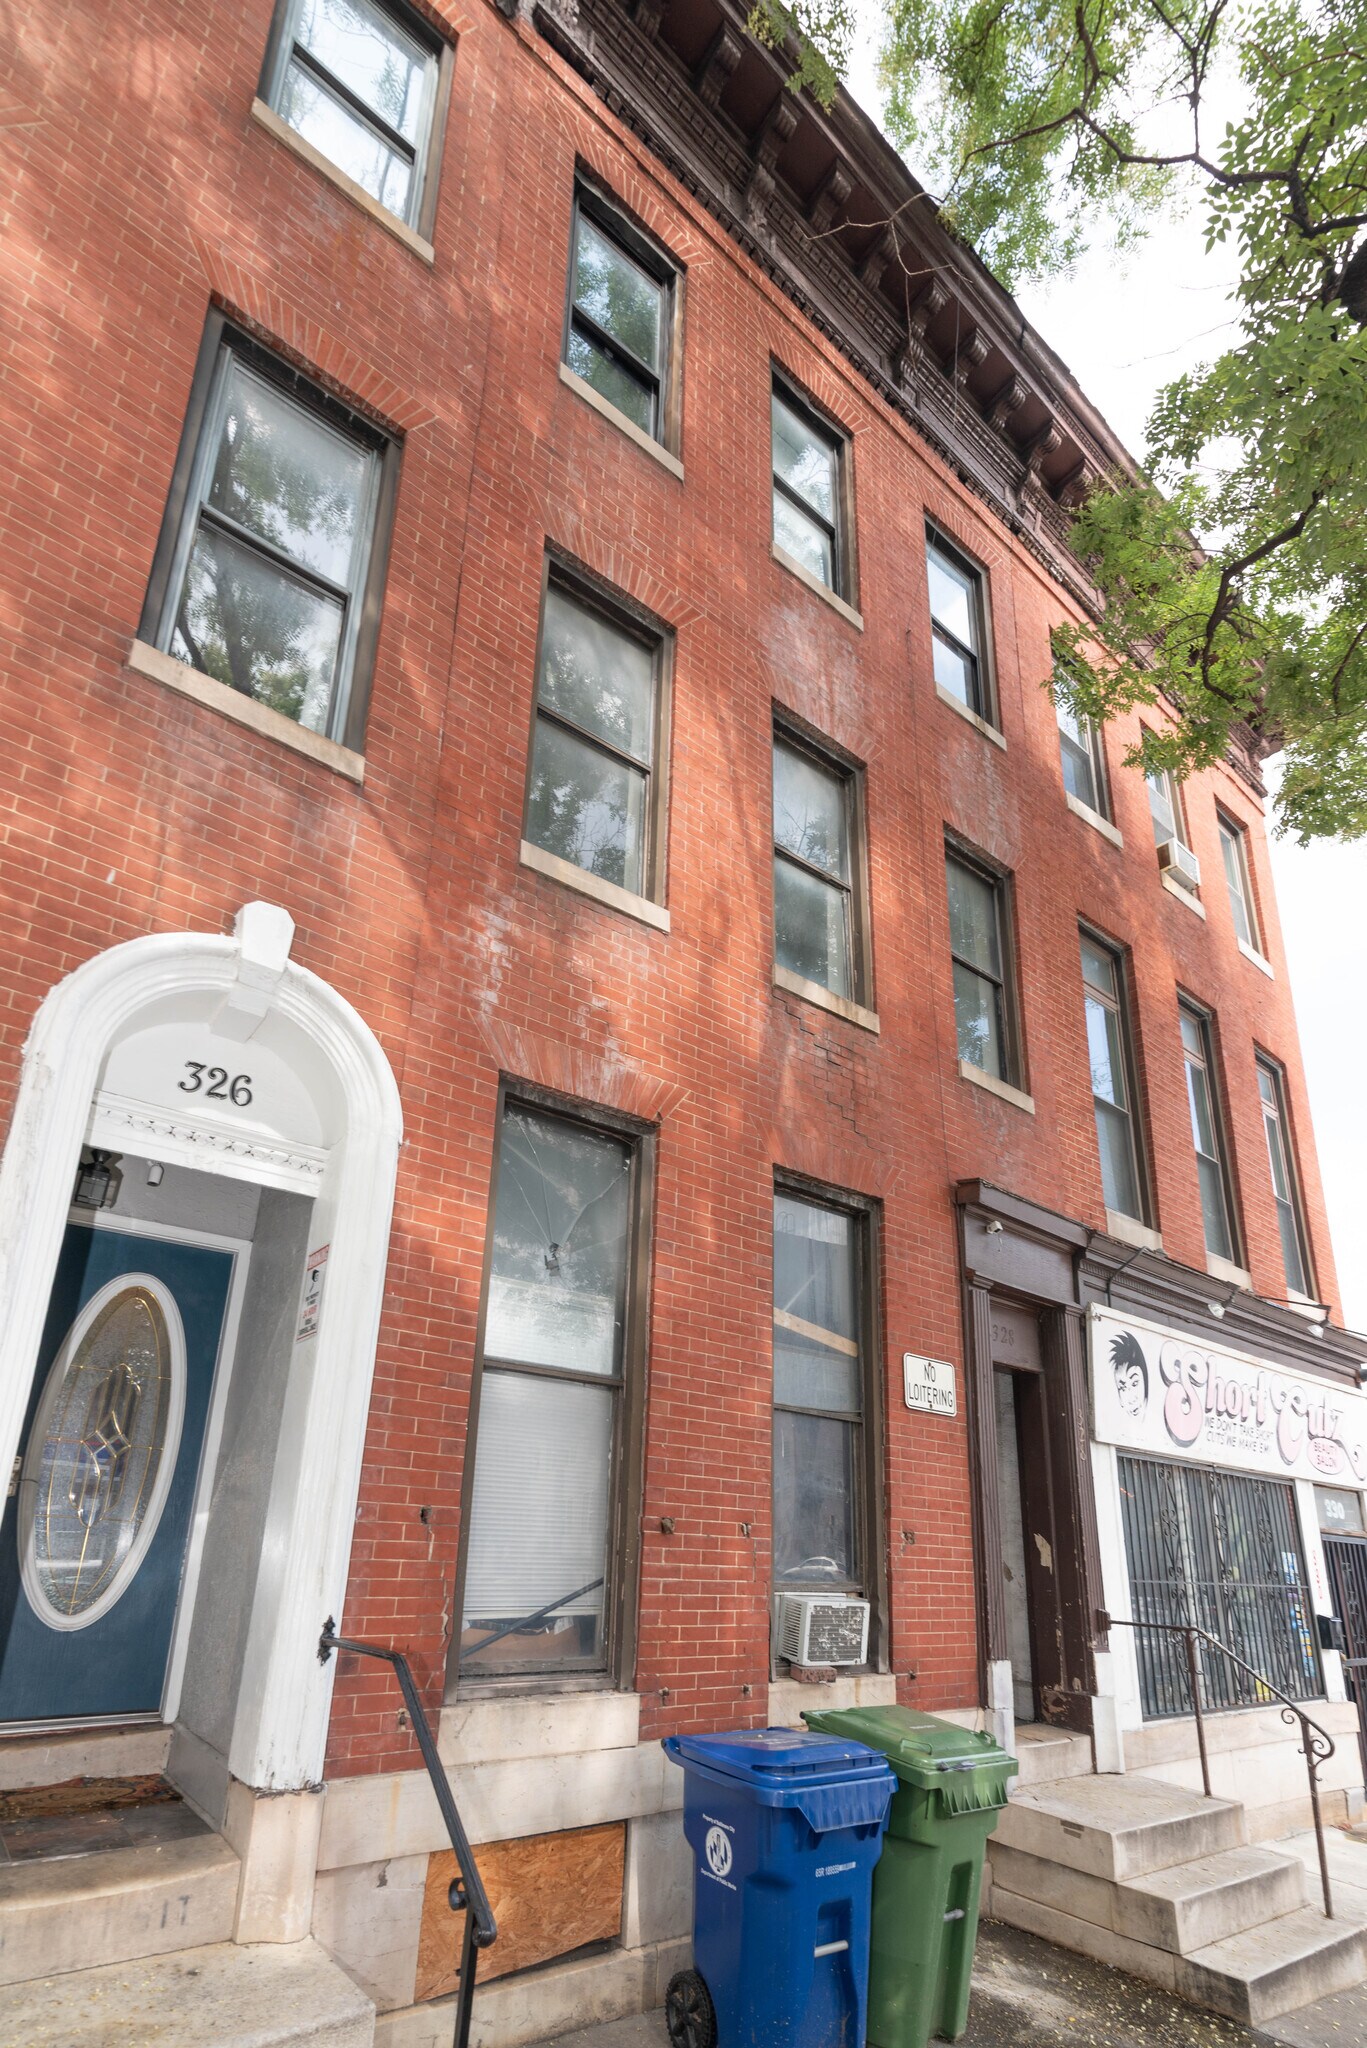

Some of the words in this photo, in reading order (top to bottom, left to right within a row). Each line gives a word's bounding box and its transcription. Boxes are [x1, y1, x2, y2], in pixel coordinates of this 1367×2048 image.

[177, 1060, 254, 1107] 326
[992, 1324, 1015, 1346] 328
[923, 1364, 937, 1383] NO
[908, 1382, 953, 1408] LOITERING
[1159, 1340, 1267, 1447] Short
[1204, 1416, 1215, 1428] WE
[1226, 1435, 1237, 1448] WE
[1324, 1498, 1345, 1520] 330
